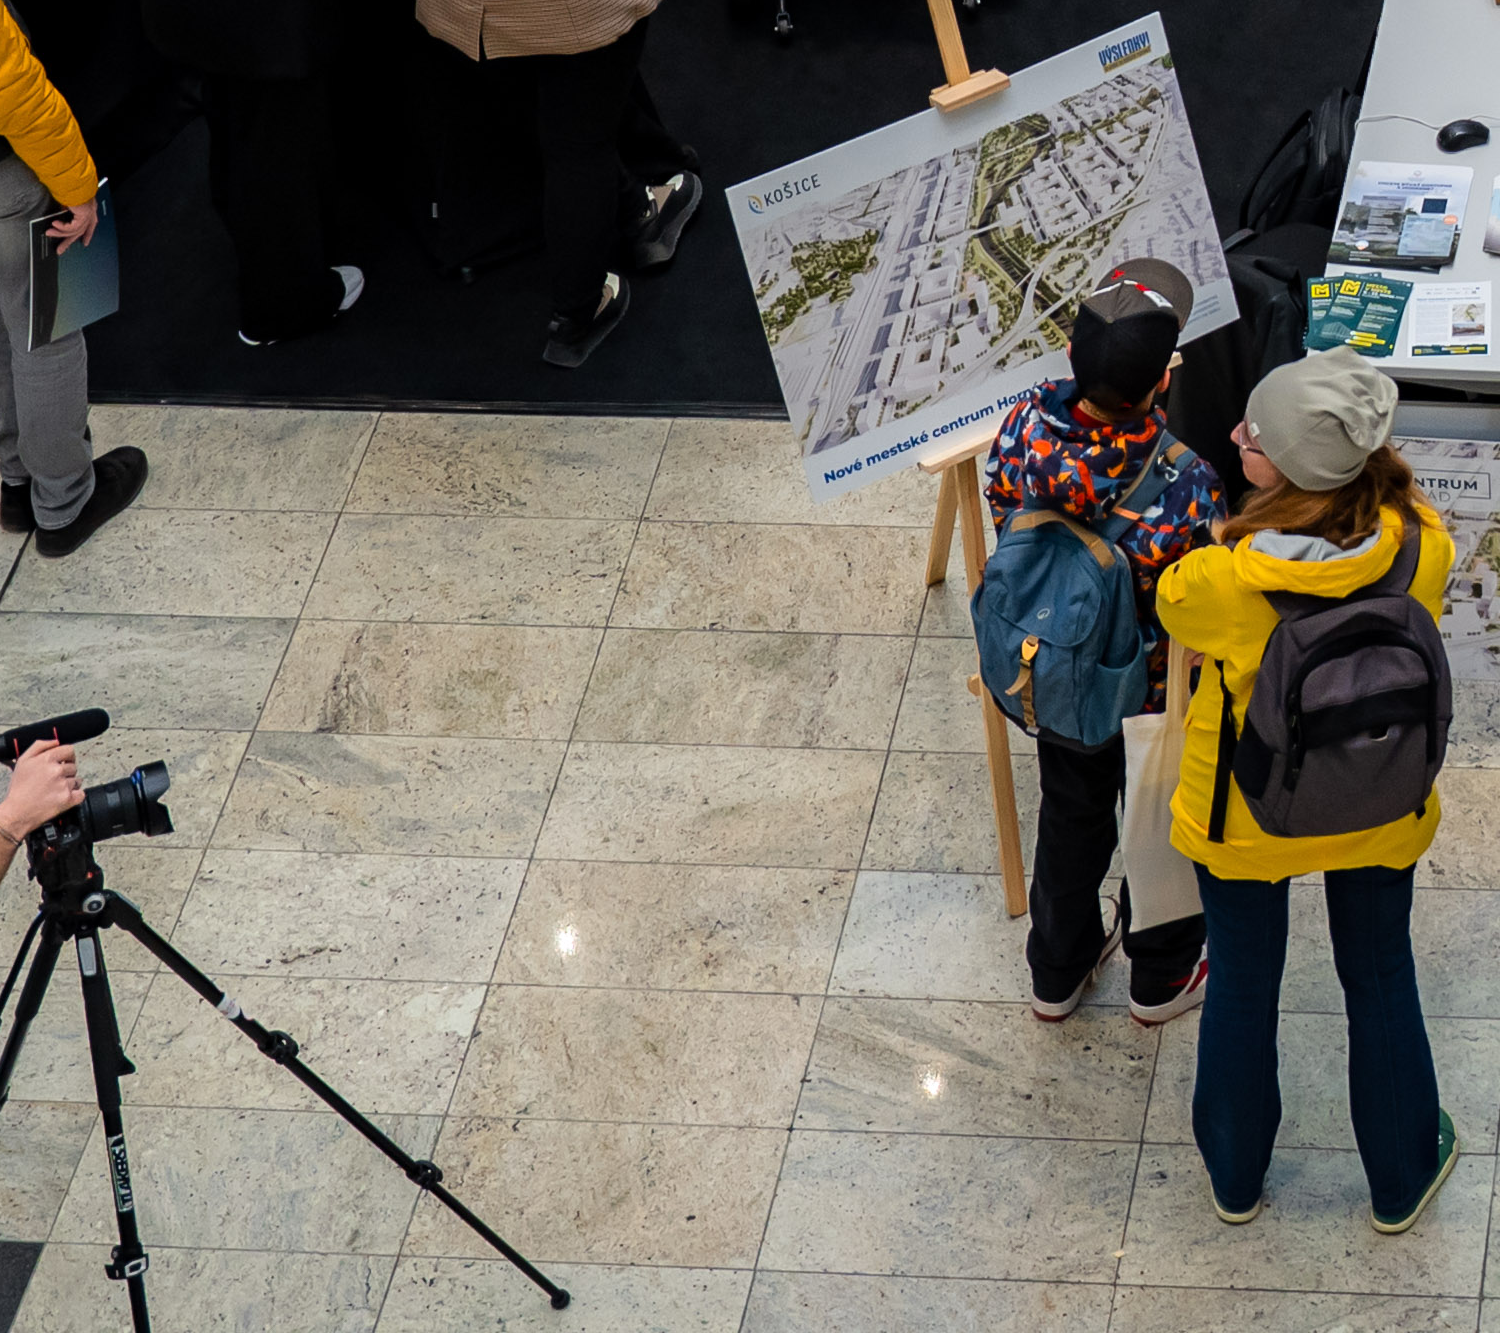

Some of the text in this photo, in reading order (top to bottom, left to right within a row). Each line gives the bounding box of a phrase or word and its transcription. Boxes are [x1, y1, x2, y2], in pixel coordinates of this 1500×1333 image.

[763, 173, 822, 207] KOŠICE
[823, 405, 995, 484] Nové mestské centrum
